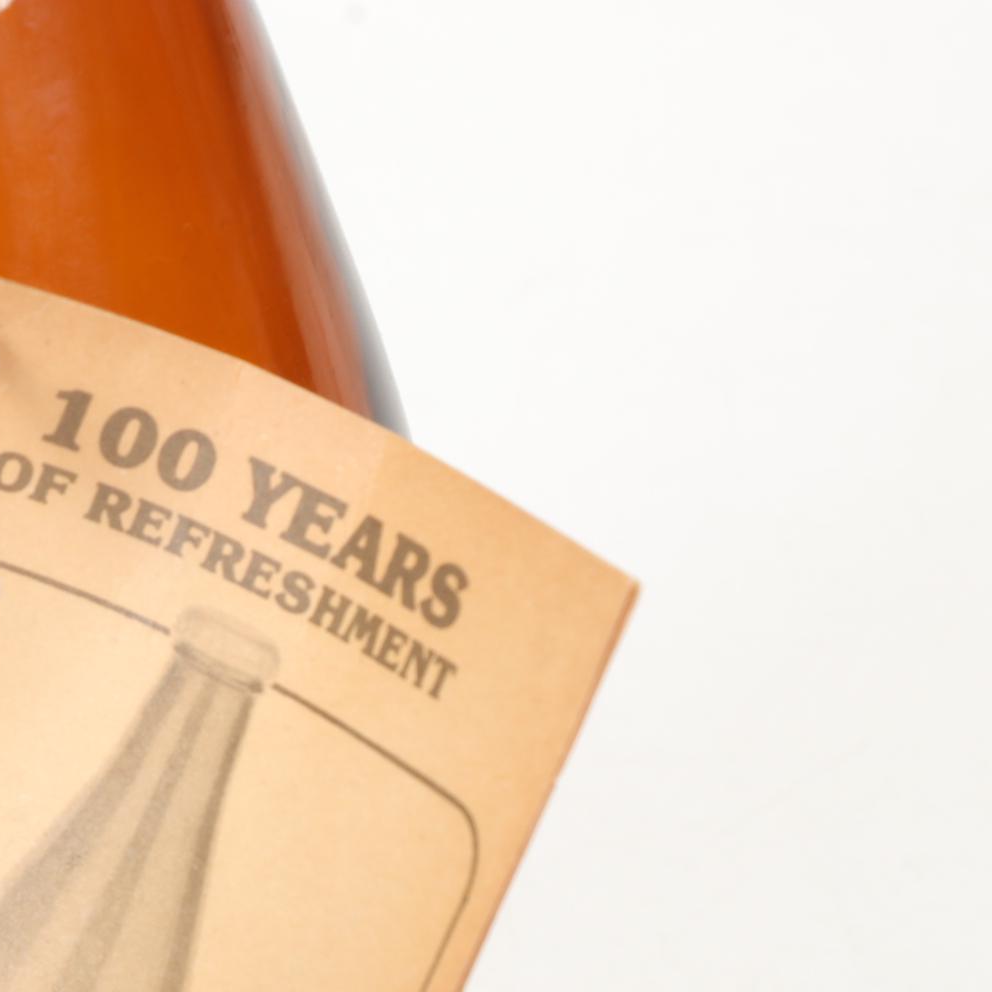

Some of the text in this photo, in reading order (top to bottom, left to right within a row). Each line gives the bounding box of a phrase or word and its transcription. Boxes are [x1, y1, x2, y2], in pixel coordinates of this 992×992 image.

[42, 387, 470, 630] 100 YEARS
[82, 481, 458, 700] REFRESHMENT
